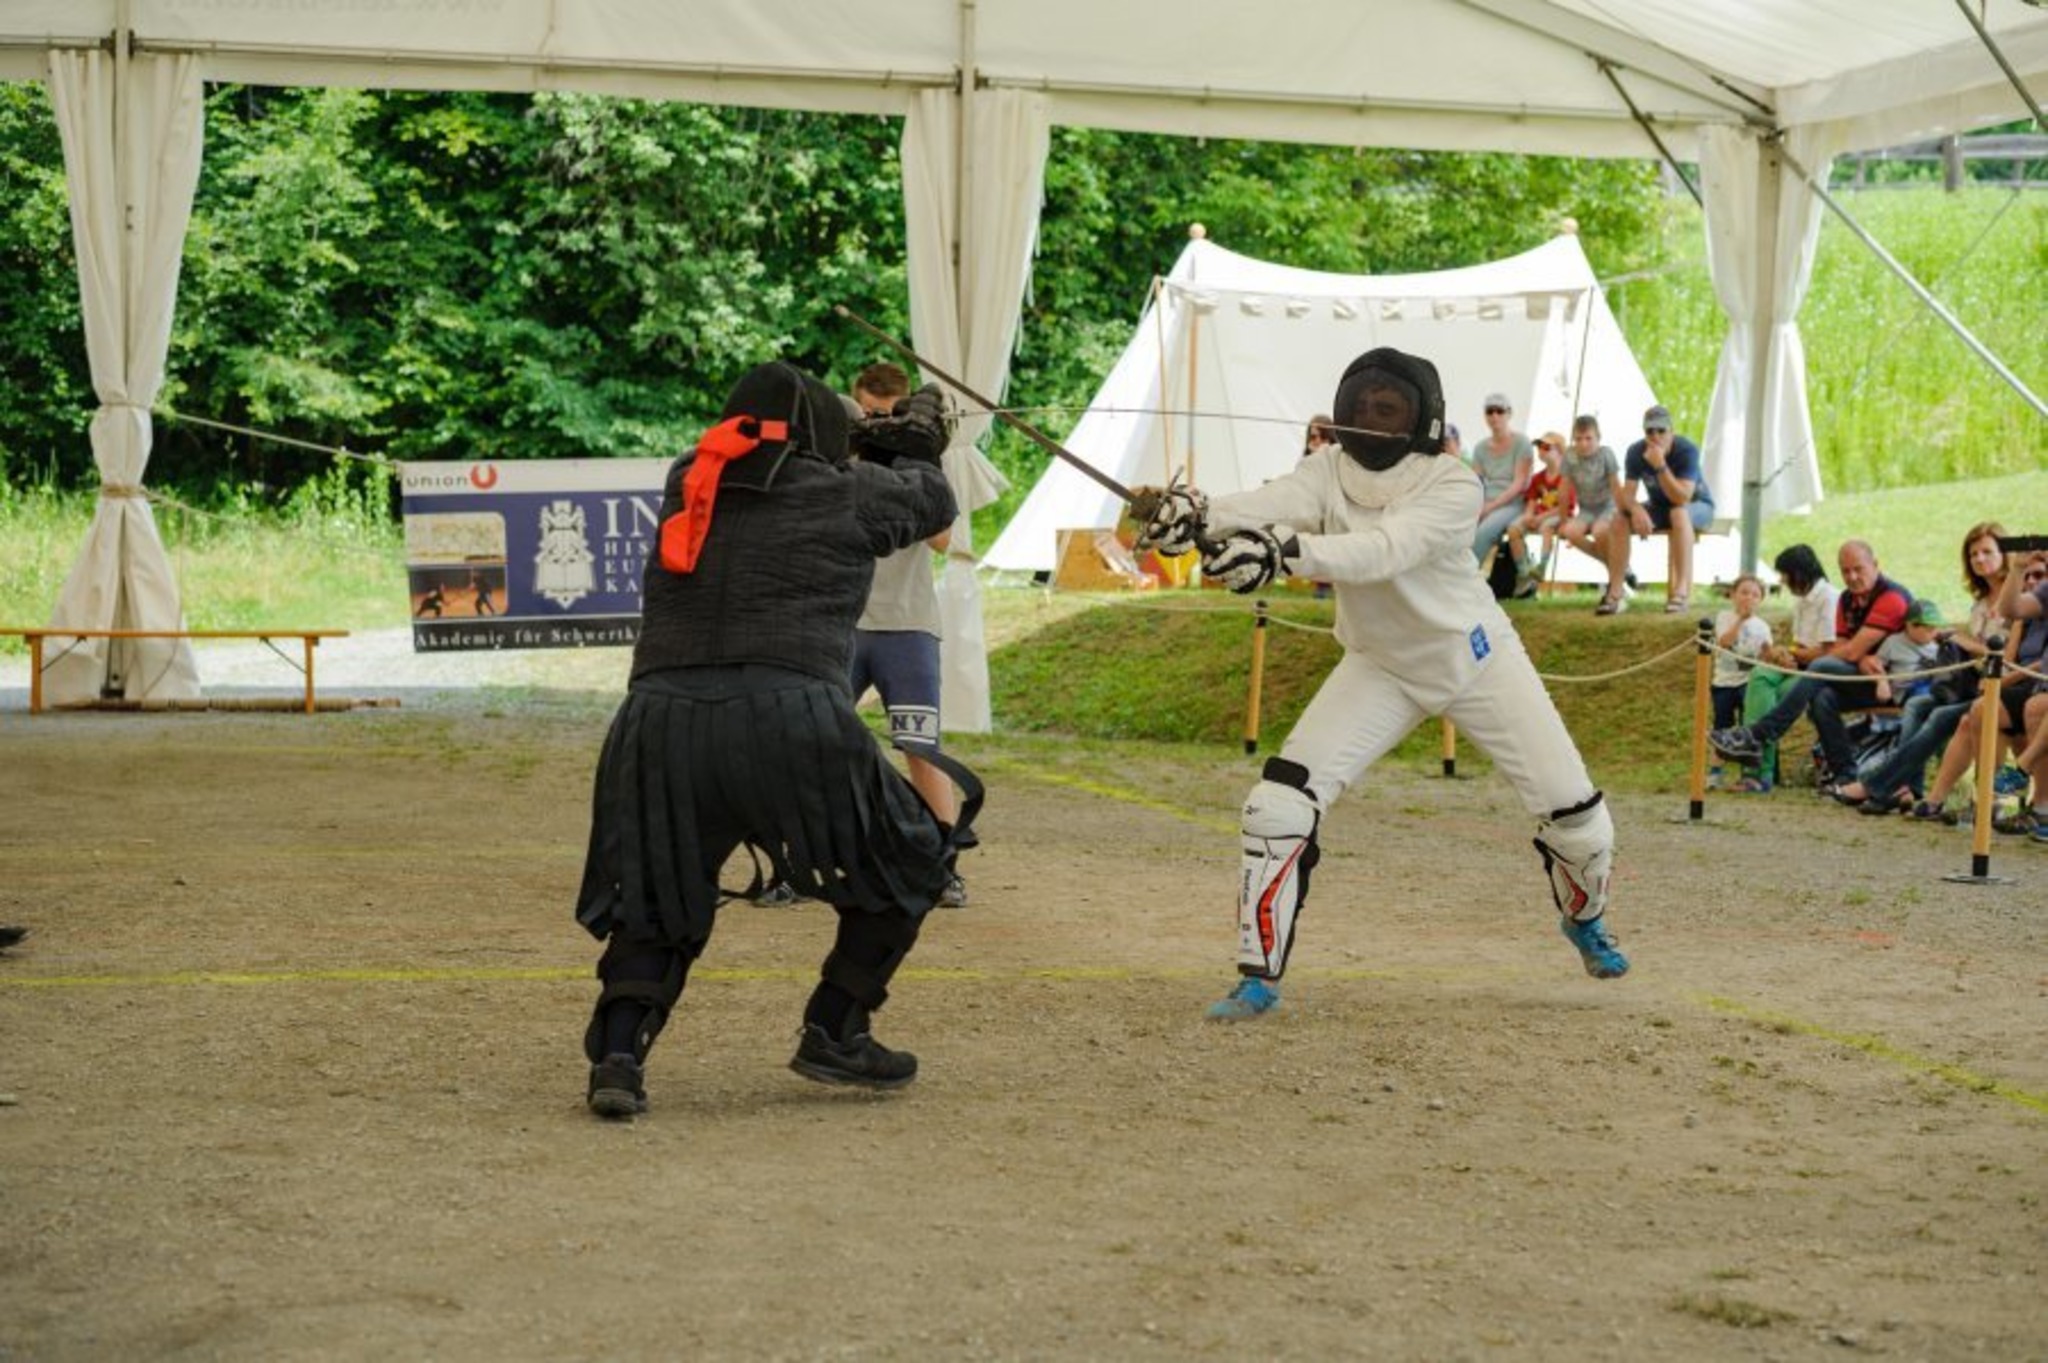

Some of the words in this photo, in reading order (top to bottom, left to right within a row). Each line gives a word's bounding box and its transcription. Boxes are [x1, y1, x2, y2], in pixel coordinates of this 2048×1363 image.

[406, 475, 468, 488] union
[416, 630, 506, 647] Akademie
[515, 630, 541, 645] für
[892, 714, 927, 732] NY
